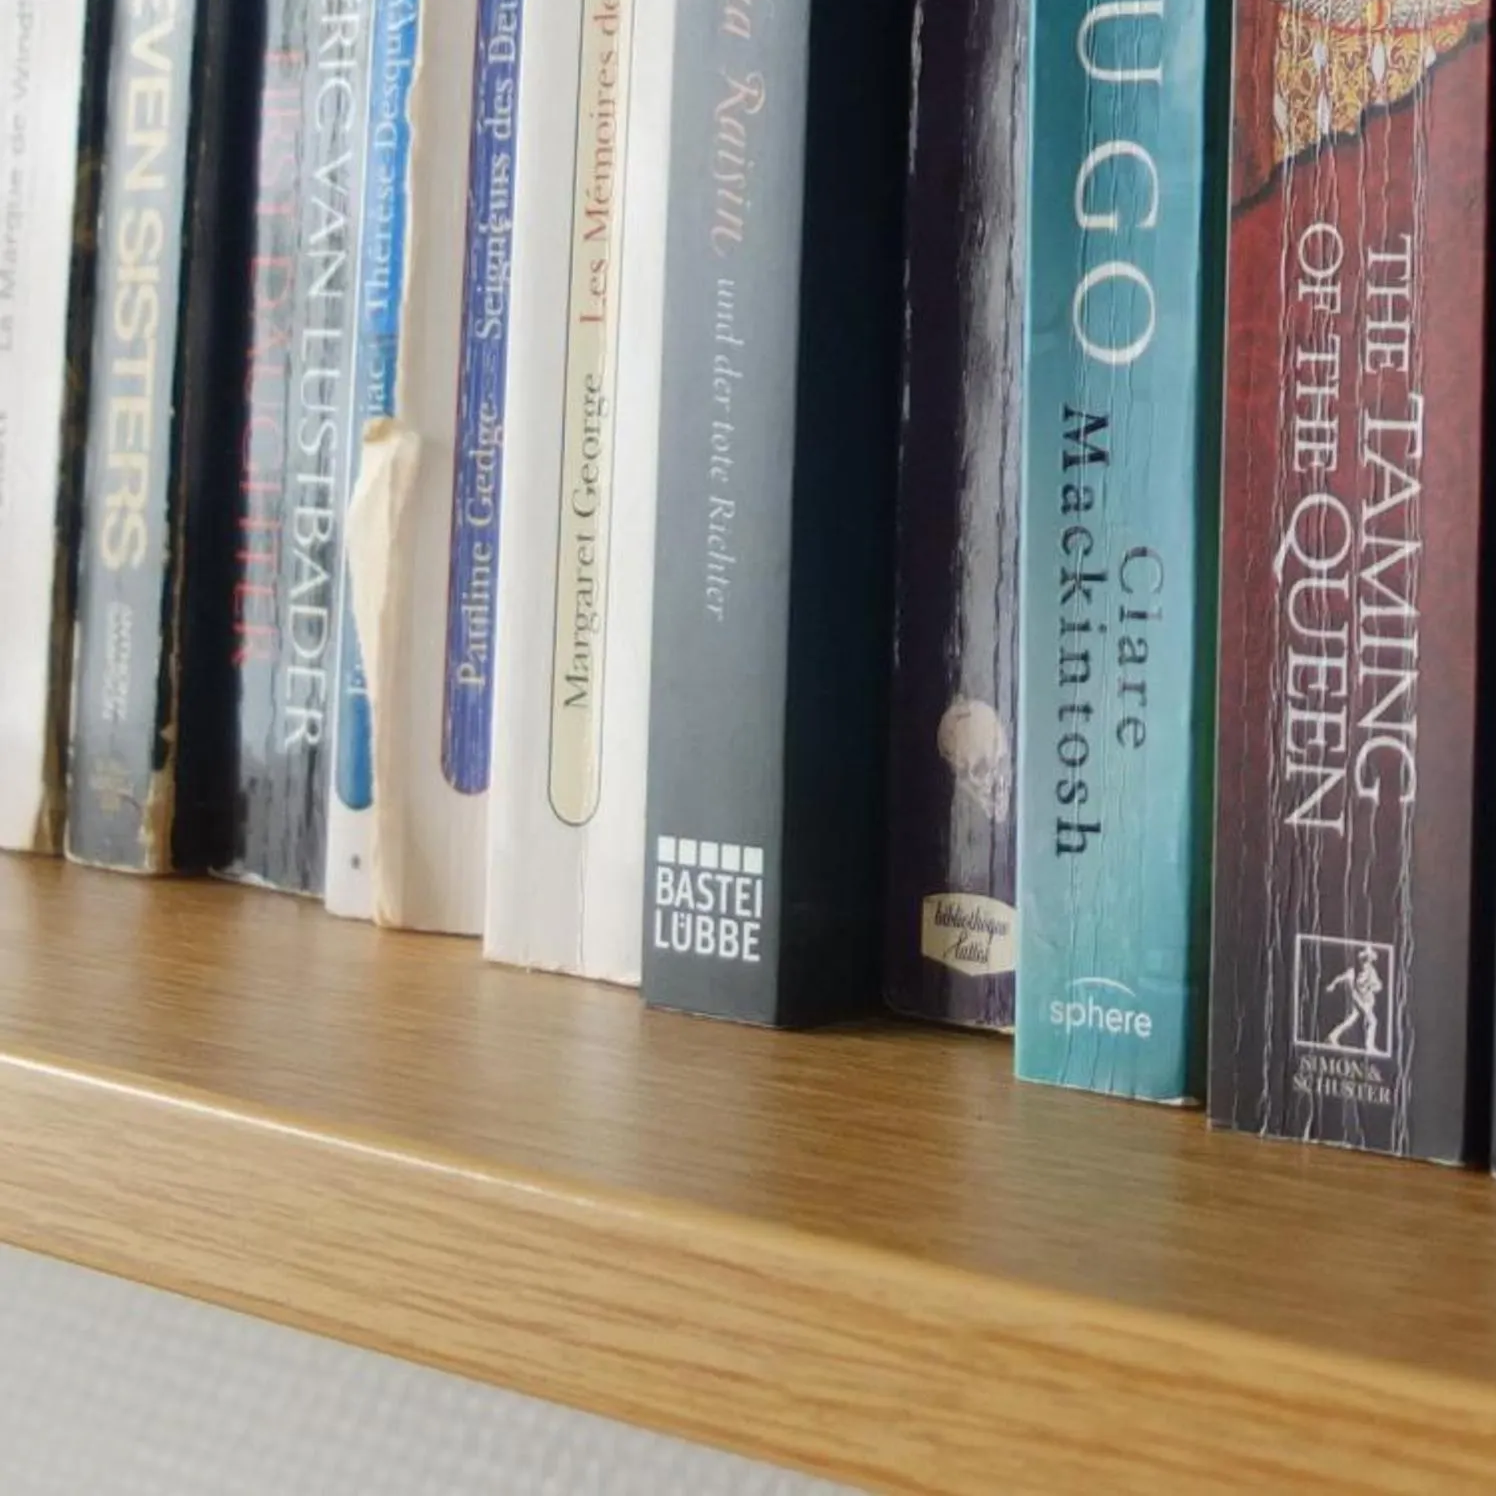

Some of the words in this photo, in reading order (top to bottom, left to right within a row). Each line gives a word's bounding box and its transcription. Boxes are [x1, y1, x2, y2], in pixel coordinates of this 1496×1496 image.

[482, 77, 514, 140] des
[583, 51, 620, 244] Mémoires
[709, 65, 766, 259] Raisin
[306, 150, 353, 299] VAN
[475, 152, 513, 340] Seigneurs
[578, 258, 608, 324] Les
[1073, 139, 1160, 366] GO
[1298, 222, 1343, 314] OF
[714, 277, 745, 347] und
[1365, 233, 1413, 374] THE
[101, 207, 165, 571] SISTERS
[572, 372, 609, 518] George
[709, 414, 736, 485] tote
[712, 353, 744, 412] der
[1294, 335, 1341, 472] THE
[231, 255, 294, 666] DAUGHTER
[465, 404, 503, 527] Gedge
[283, 326, 343, 751] LUSTBADER
[705, 493, 737, 623] Richter
[1354, 391, 1424, 804] TAMING
[456, 541, 494, 686] Pauline
[562, 533, 600, 710] Margaret
[1056, 405, 1110, 858] Mackintosh
[1116, 545, 1164, 750] Clare
[1272, 493, 1351, 838] QUEEN
[655, 909, 760, 962] LÜBBE
[656, 865, 763, 918] BASTEI
[1050, 995, 1153, 1038] sphere
[1301, 1056, 1364, 1081] SIMON
[1293, 1073, 1391, 1104] SCHUSTER
